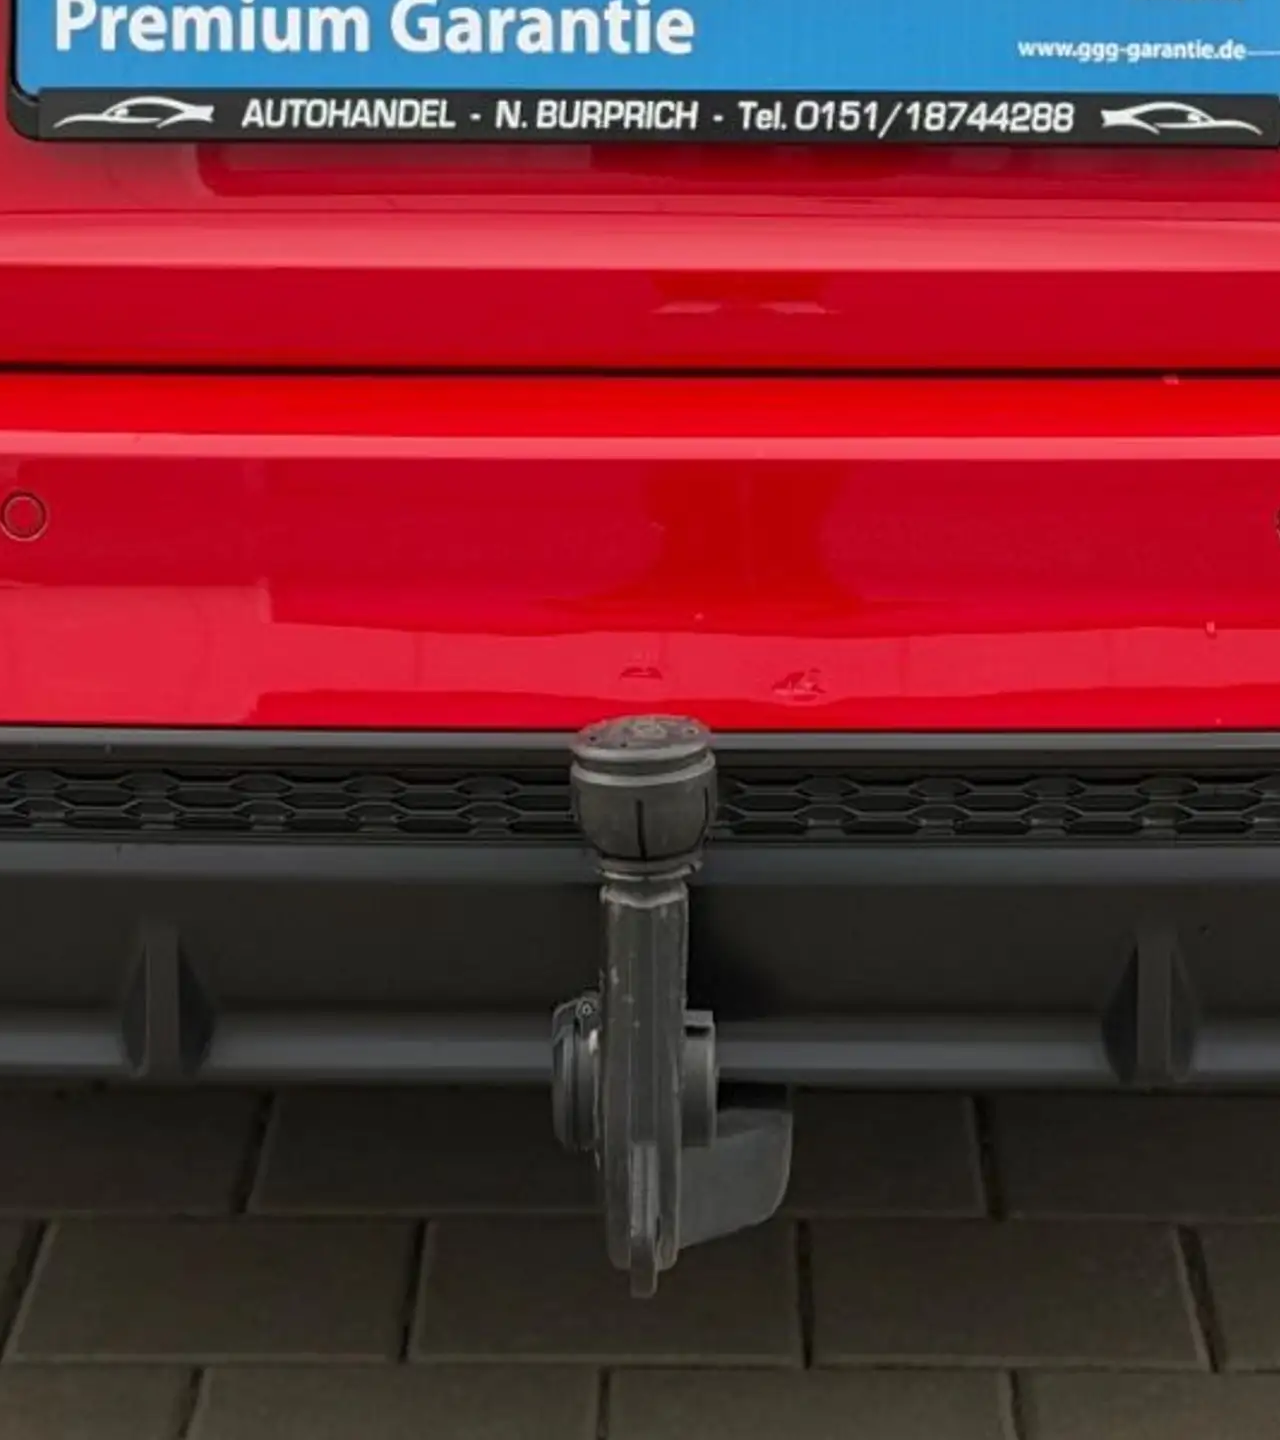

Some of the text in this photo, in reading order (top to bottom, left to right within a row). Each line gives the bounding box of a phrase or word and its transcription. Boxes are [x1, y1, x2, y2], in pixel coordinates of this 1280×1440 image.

[1019, 39, 1247, 63] www.ggg-garantie.de
[241, 98, 457, 129] AUTOHANDEL
[495, 99, 528, 129] N.
[536, 99, 699, 130] BURPRICH
[737, 100, 787, 130] Tel.
[794, 100, 1075, 139] 0151/18744288
